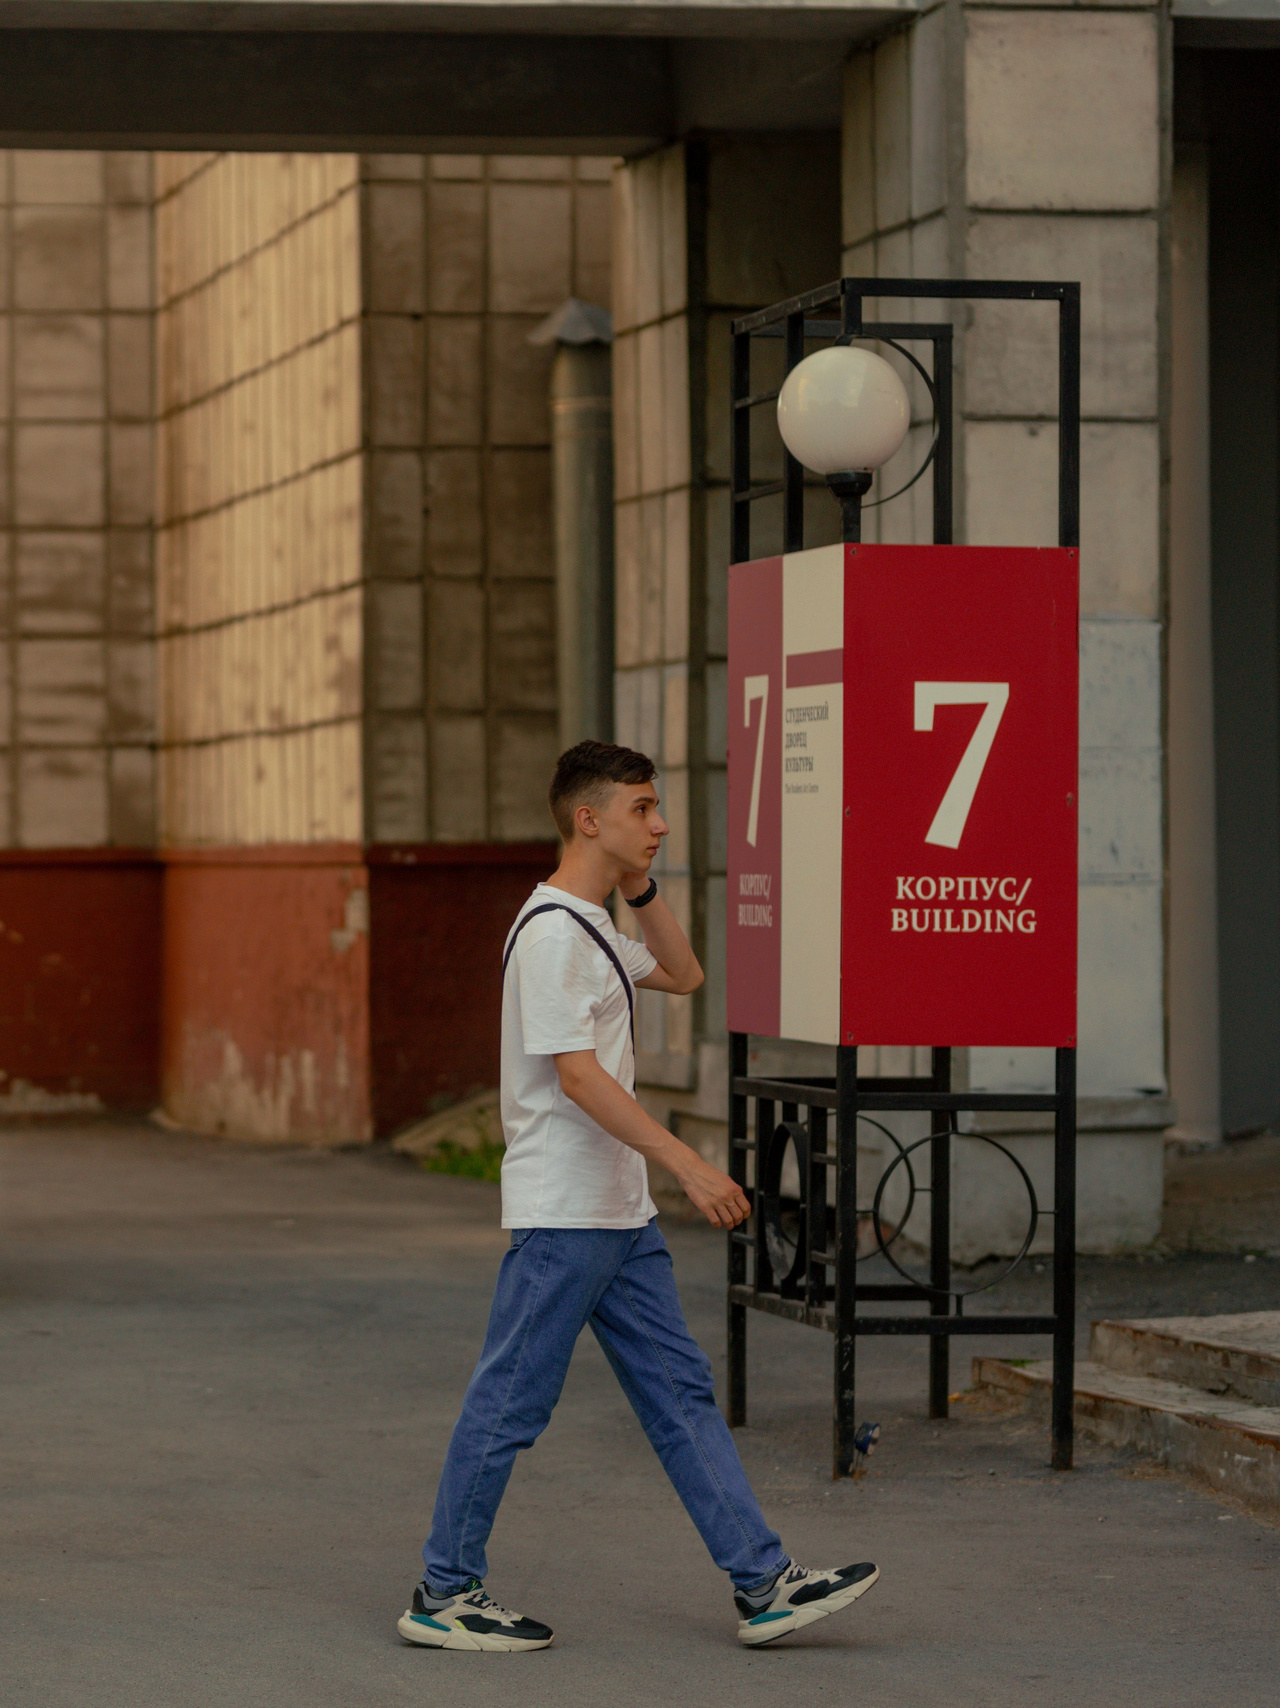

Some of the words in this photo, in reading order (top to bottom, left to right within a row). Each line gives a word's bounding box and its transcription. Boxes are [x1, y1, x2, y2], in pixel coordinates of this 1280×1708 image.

[785, 701, 829, 724] СТУДЕНЧЕСКИЙ
[785, 732, 808, 749] ДВОРЕЦ
[744, 674, 769, 848] 7
[785, 756, 814, 773] КУЛЬТУРЫ
[913, 681, 1010, 850] 7
[896, 876, 1032, 906] КОРПУС/
[738, 903, 773, 928] BUILDING
[891, 908, 1037, 934] BUILDING
